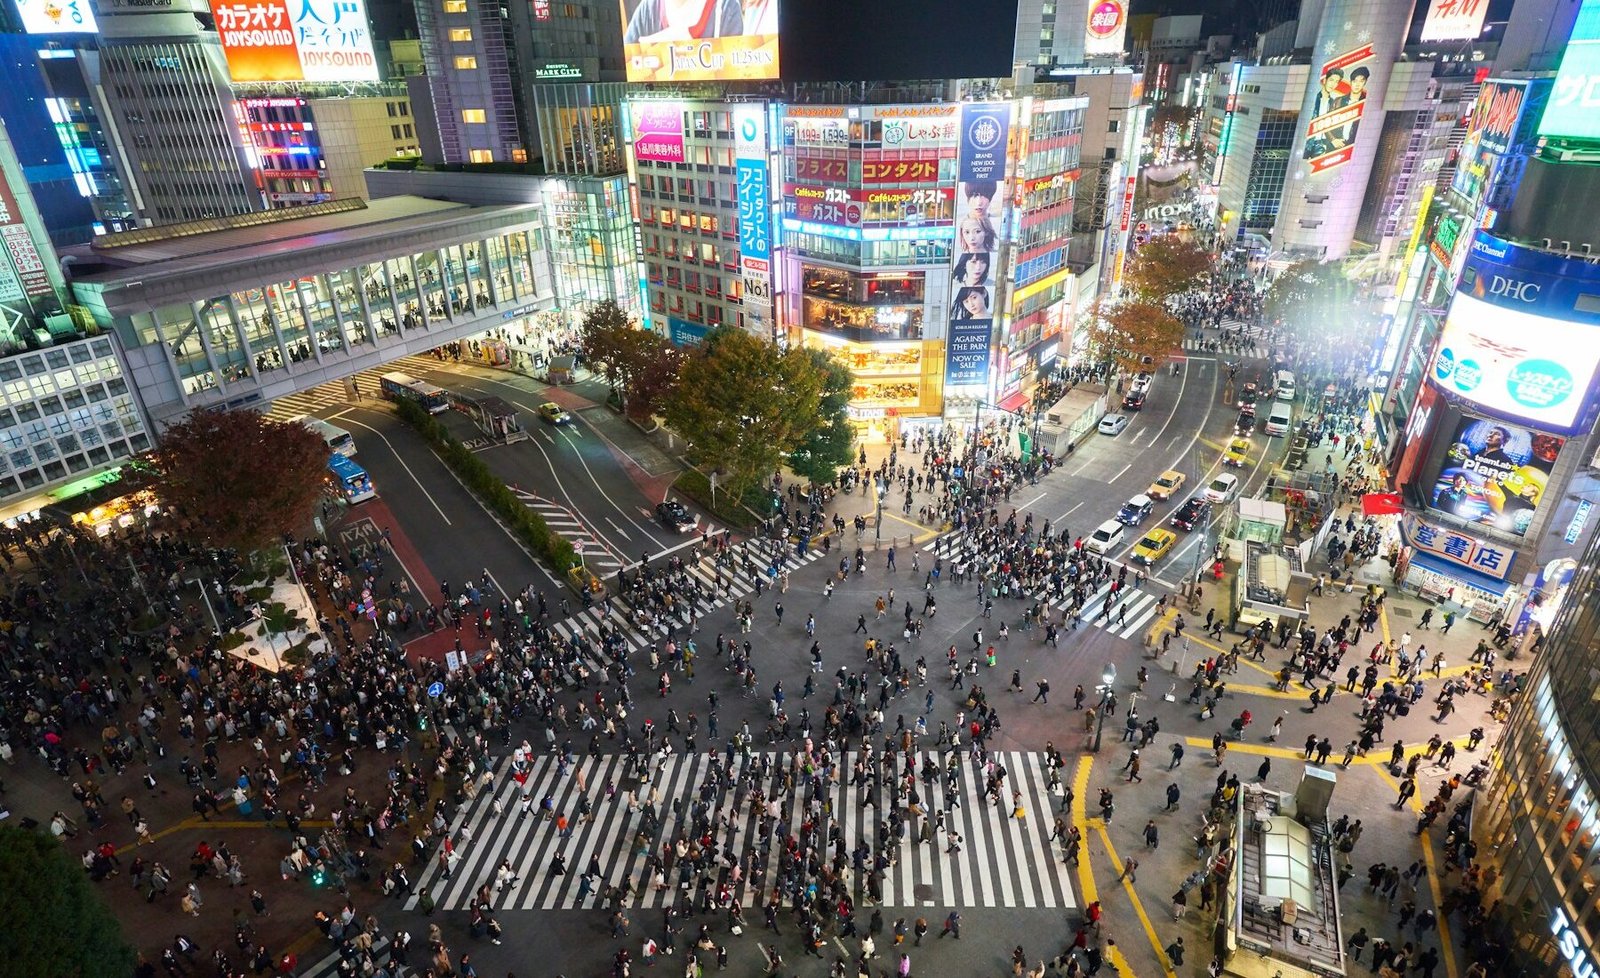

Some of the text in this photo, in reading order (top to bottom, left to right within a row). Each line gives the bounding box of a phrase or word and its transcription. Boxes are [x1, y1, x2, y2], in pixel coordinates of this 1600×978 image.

[216, 3, 286, 29] カラオケ
[1434, 0, 1479, 18] H&M
[224, 28, 294, 47] JOYSOUND
[302, 50, 373, 67] JOYSOUND
[863, 162, 936, 178] コンタクト
[825, 187, 851, 204] ガスト
[912, 188, 947, 204] ガスト
[739, 167, 754, 251] アイシティ
[753, 168, 765, 252] コンタクトの
[812, 203, 843, 223] ガスト
[1482, 242, 1506, 258] Channel
[744, 278, 769, 299] No.1
[1489, 275, 1541, 303] DHC
[952, 342, 988, 351] THE PAIN
[954, 335, 987, 343] AGAINST
[959, 361, 976, 369] SALE
[1474, 454, 1512, 470] teamLab
[1462, 458, 1524, 485] Planets
[1550, 906, 1600, 978] TSU
